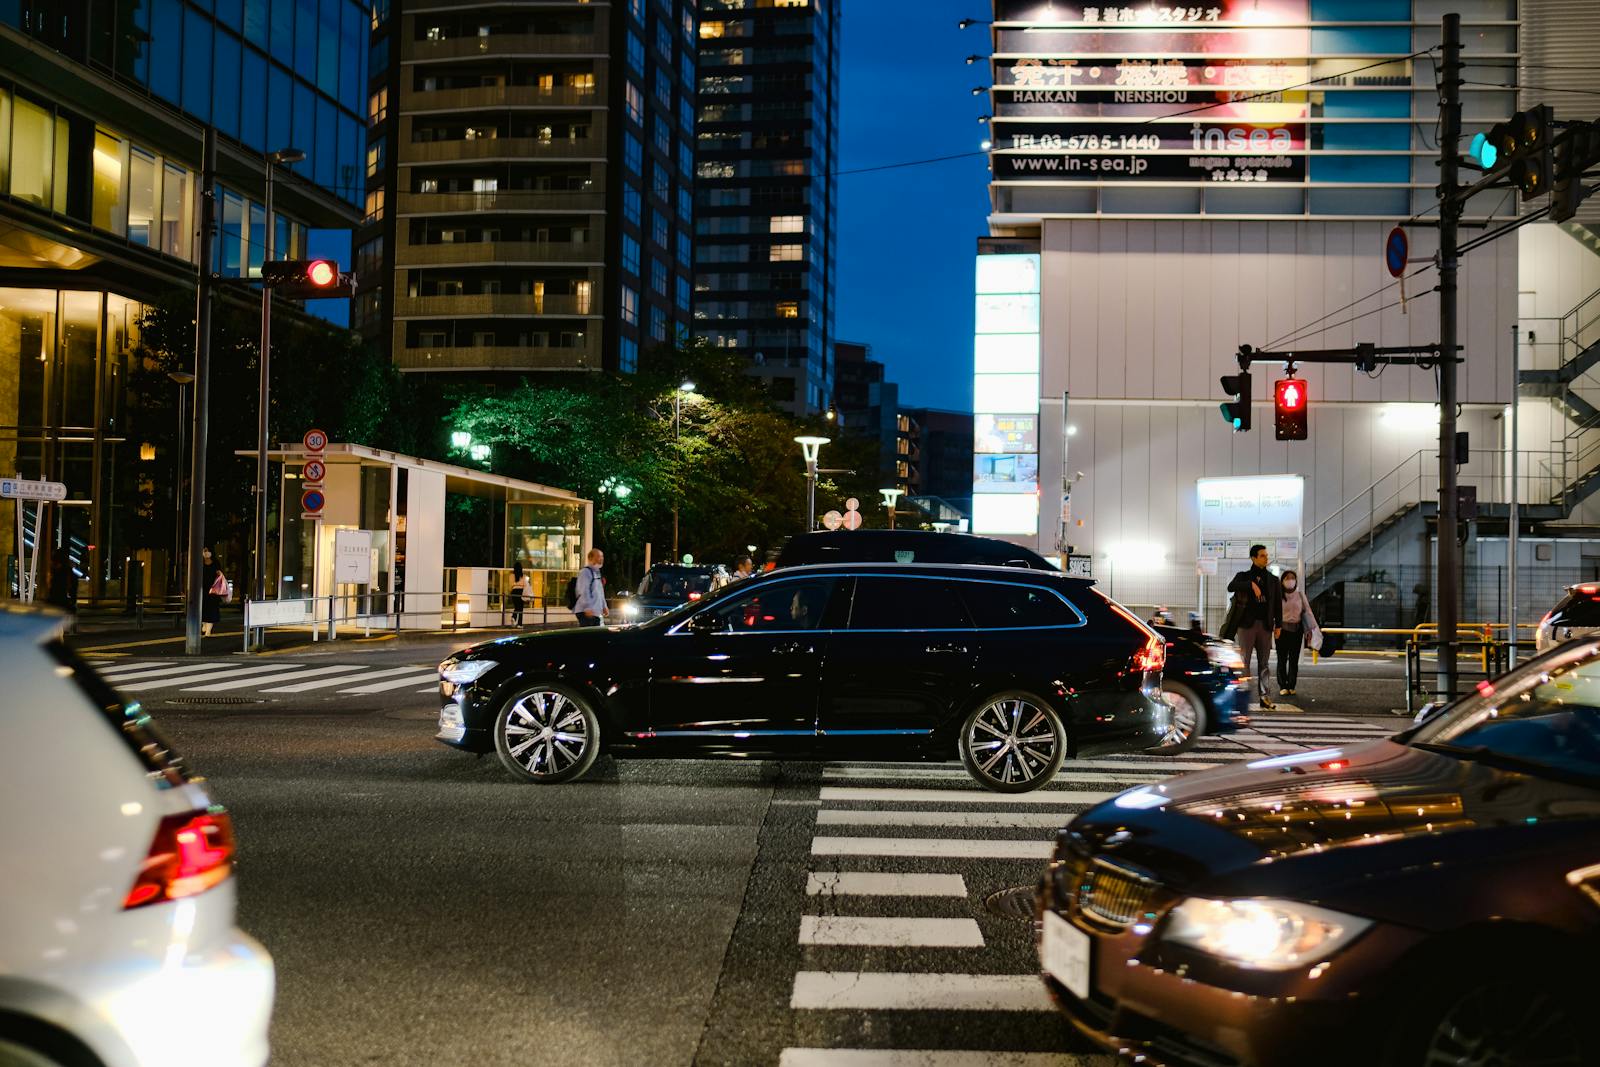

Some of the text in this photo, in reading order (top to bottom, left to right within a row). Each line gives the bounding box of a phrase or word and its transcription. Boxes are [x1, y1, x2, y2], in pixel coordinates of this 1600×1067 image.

[1013, 91, 1077, 103] HAKKAN
[1114, 91, 1188, 103] NENSHOU
[1189, 122, 1292, 151] insea
[1011, 155, 1149, 175] www.in-sea.jp
[308, 435, 322, 447] 30
